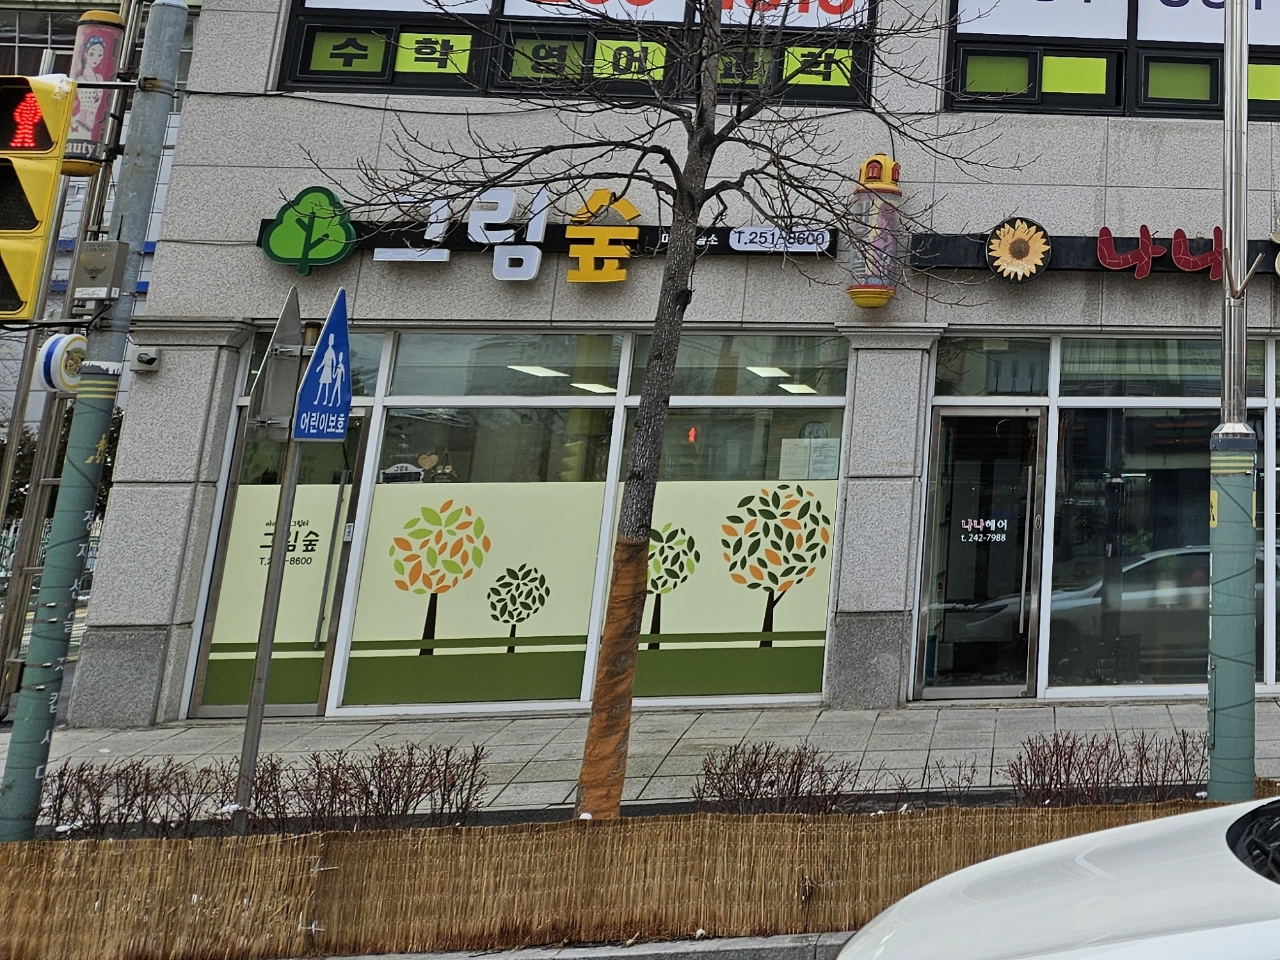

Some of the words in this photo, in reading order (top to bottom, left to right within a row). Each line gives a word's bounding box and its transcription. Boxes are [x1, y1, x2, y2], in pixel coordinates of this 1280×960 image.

[373, 187, 641, 283] 그림숲
[300, 411, 346, 435] 어린이보호
[961, 518, 1008, 532] 나나헤어
